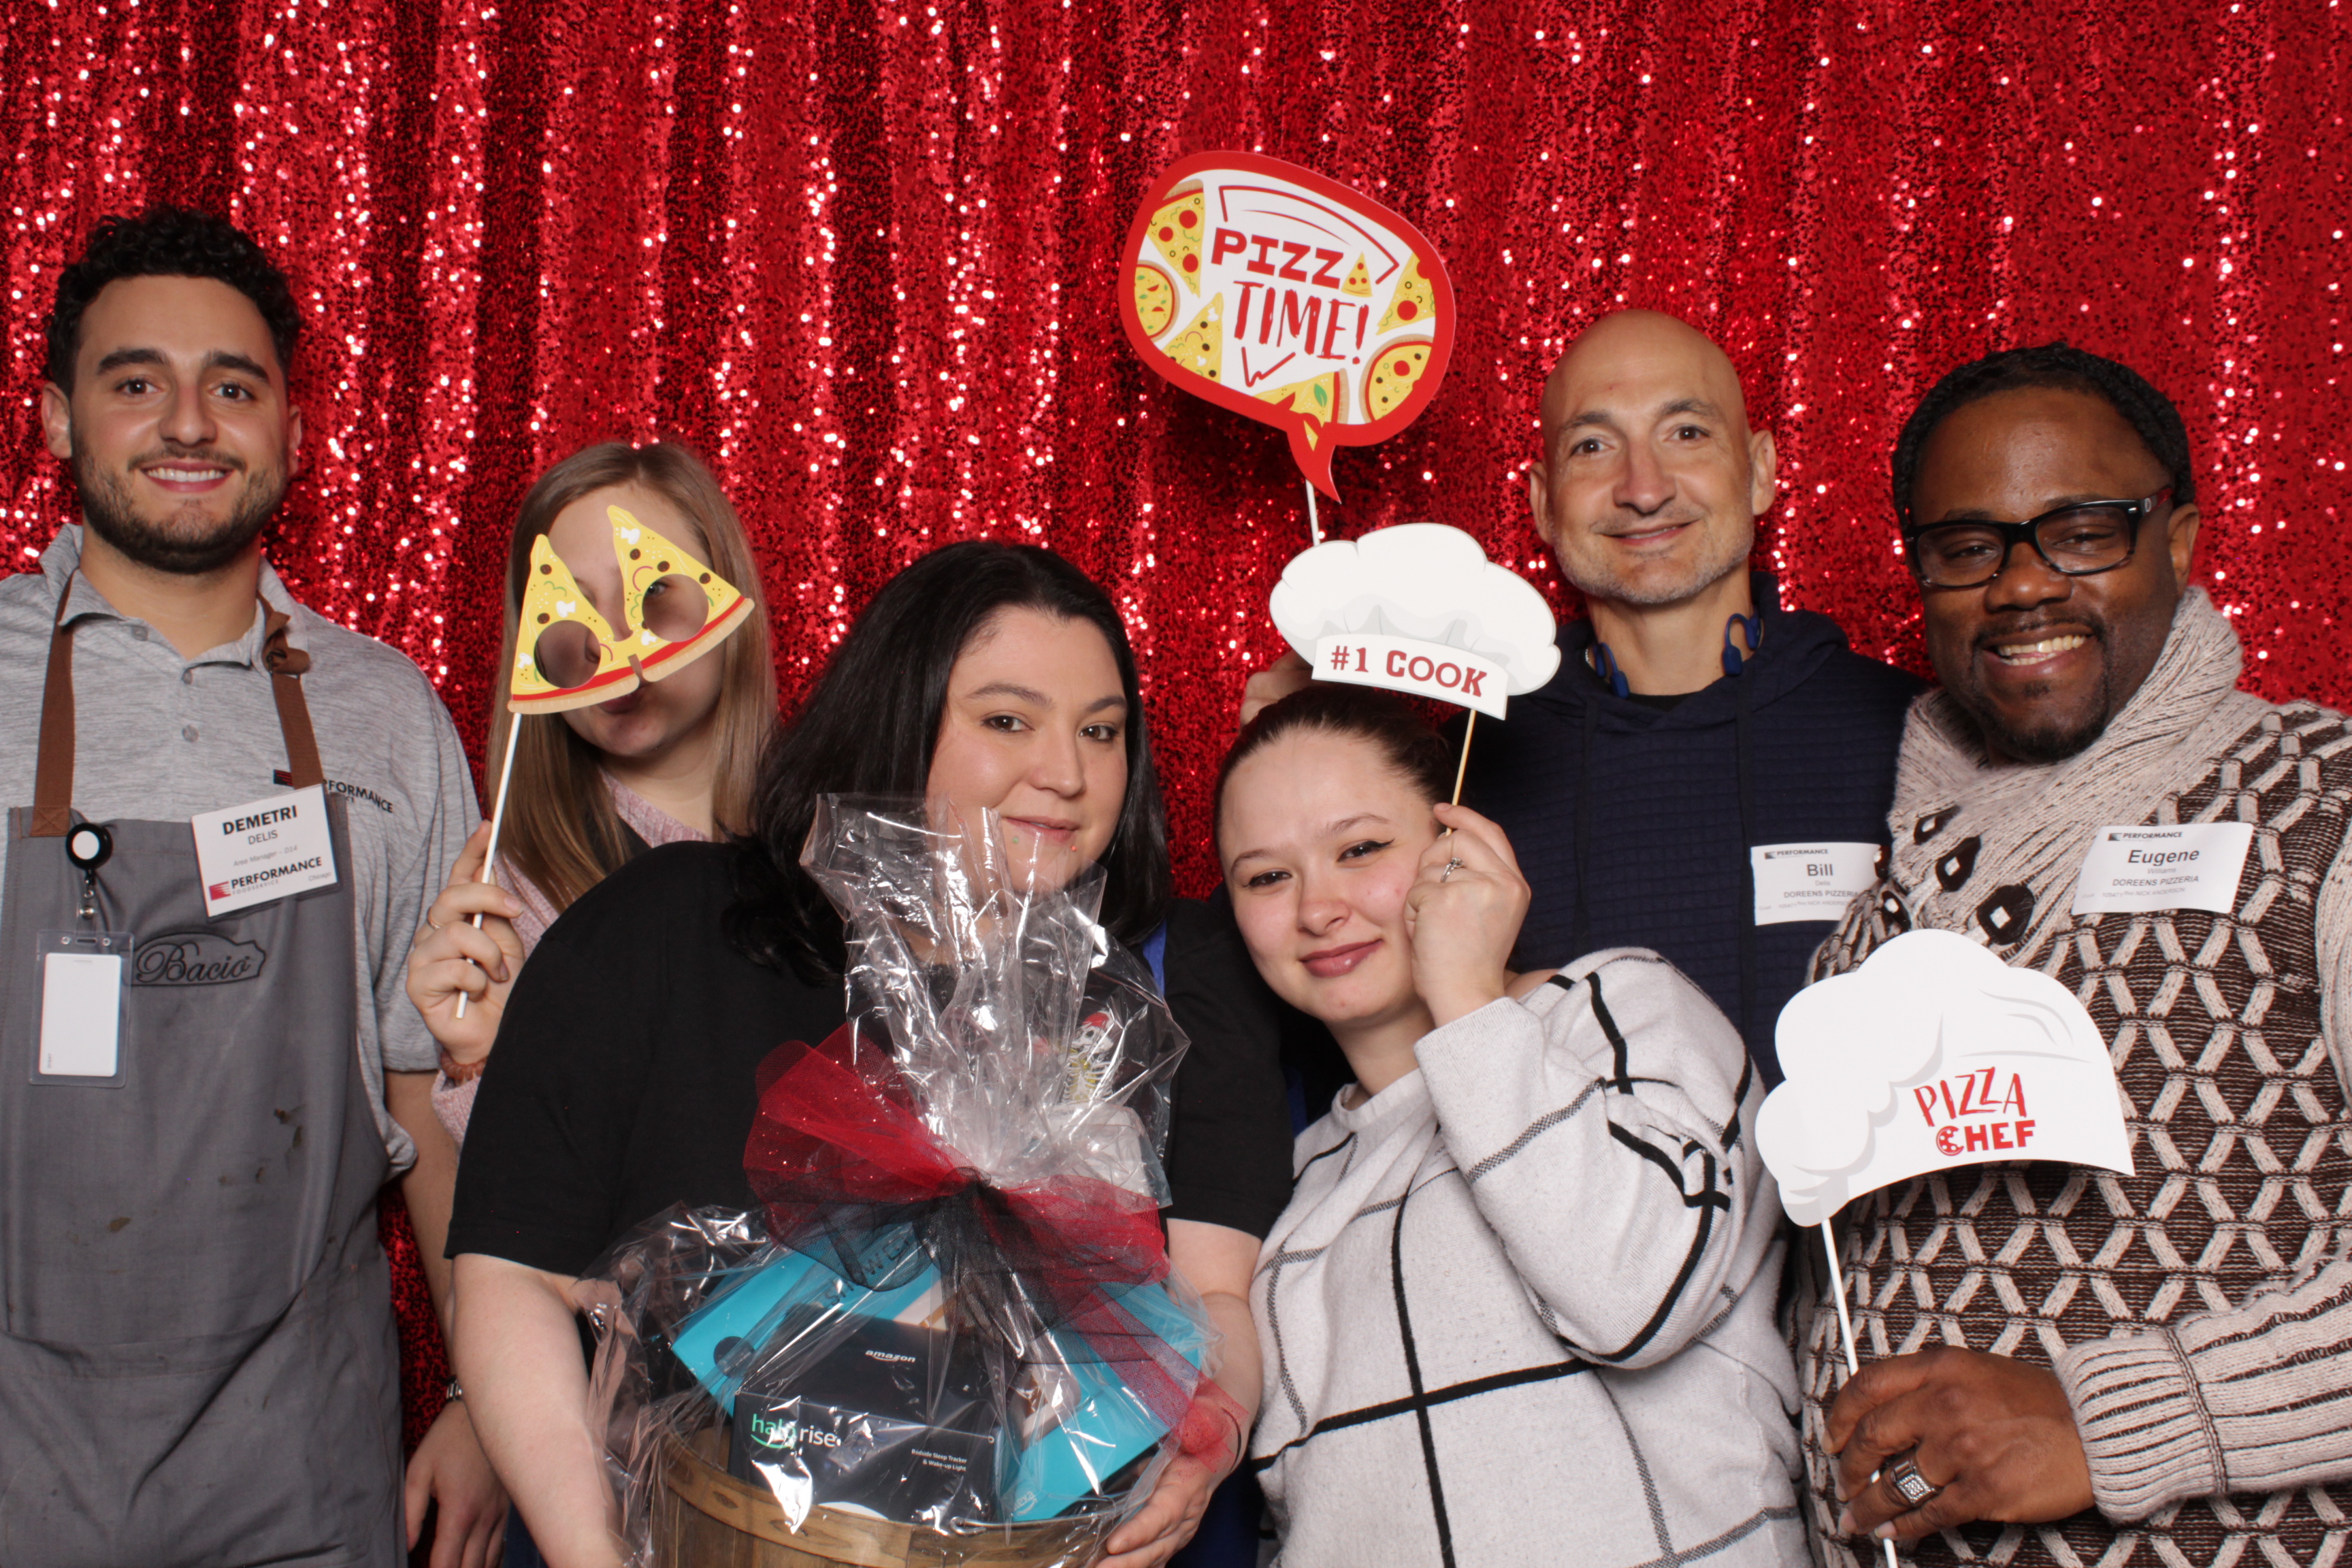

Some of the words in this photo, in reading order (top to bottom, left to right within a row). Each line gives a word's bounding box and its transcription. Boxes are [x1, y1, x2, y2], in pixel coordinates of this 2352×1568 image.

[1233, 280, 1369, 365] TIME!
[1330, 645, 1370, 673] #1
[1386, 650, 1487, 697] COOK
[223, 805, 298, 835] DEMETRI
[248, 830, 278, 845] DELIS
[2123, 832, 2183, 840] PERFORMANCE
[250, 851, 277, 862] Manager
[284, 845, 298, 853] D14
[2128, 849, 2200, 866] Eugene
[231, 857, 323, 889] PERFORMANCE
[308, 872, 332, 882] Chicago
[1807, 864, 1833, 877] Bill
[232, 879, 279, 896] FOODSERVICE
[2159, 875, 2199, 885] PIZZERIA
[1784, 890, 1823, 898] DOREENS
[2152, 887, 2186, 896] ANDERSON
[137, 943, 251, 983] Bacio
[1913, 1066, 2027, 1127] PIZZA
[1936, 1120, 2036, 1156] CHEF
[865, 1349, 916, 1363] amazon
[800, 1424, 838, 1448] rise
[911, 1448, 932, 1458] Bedside
[948, 1455, 967, 1464] Tracker
[928, 1460, 951, 1469] Wake-up
